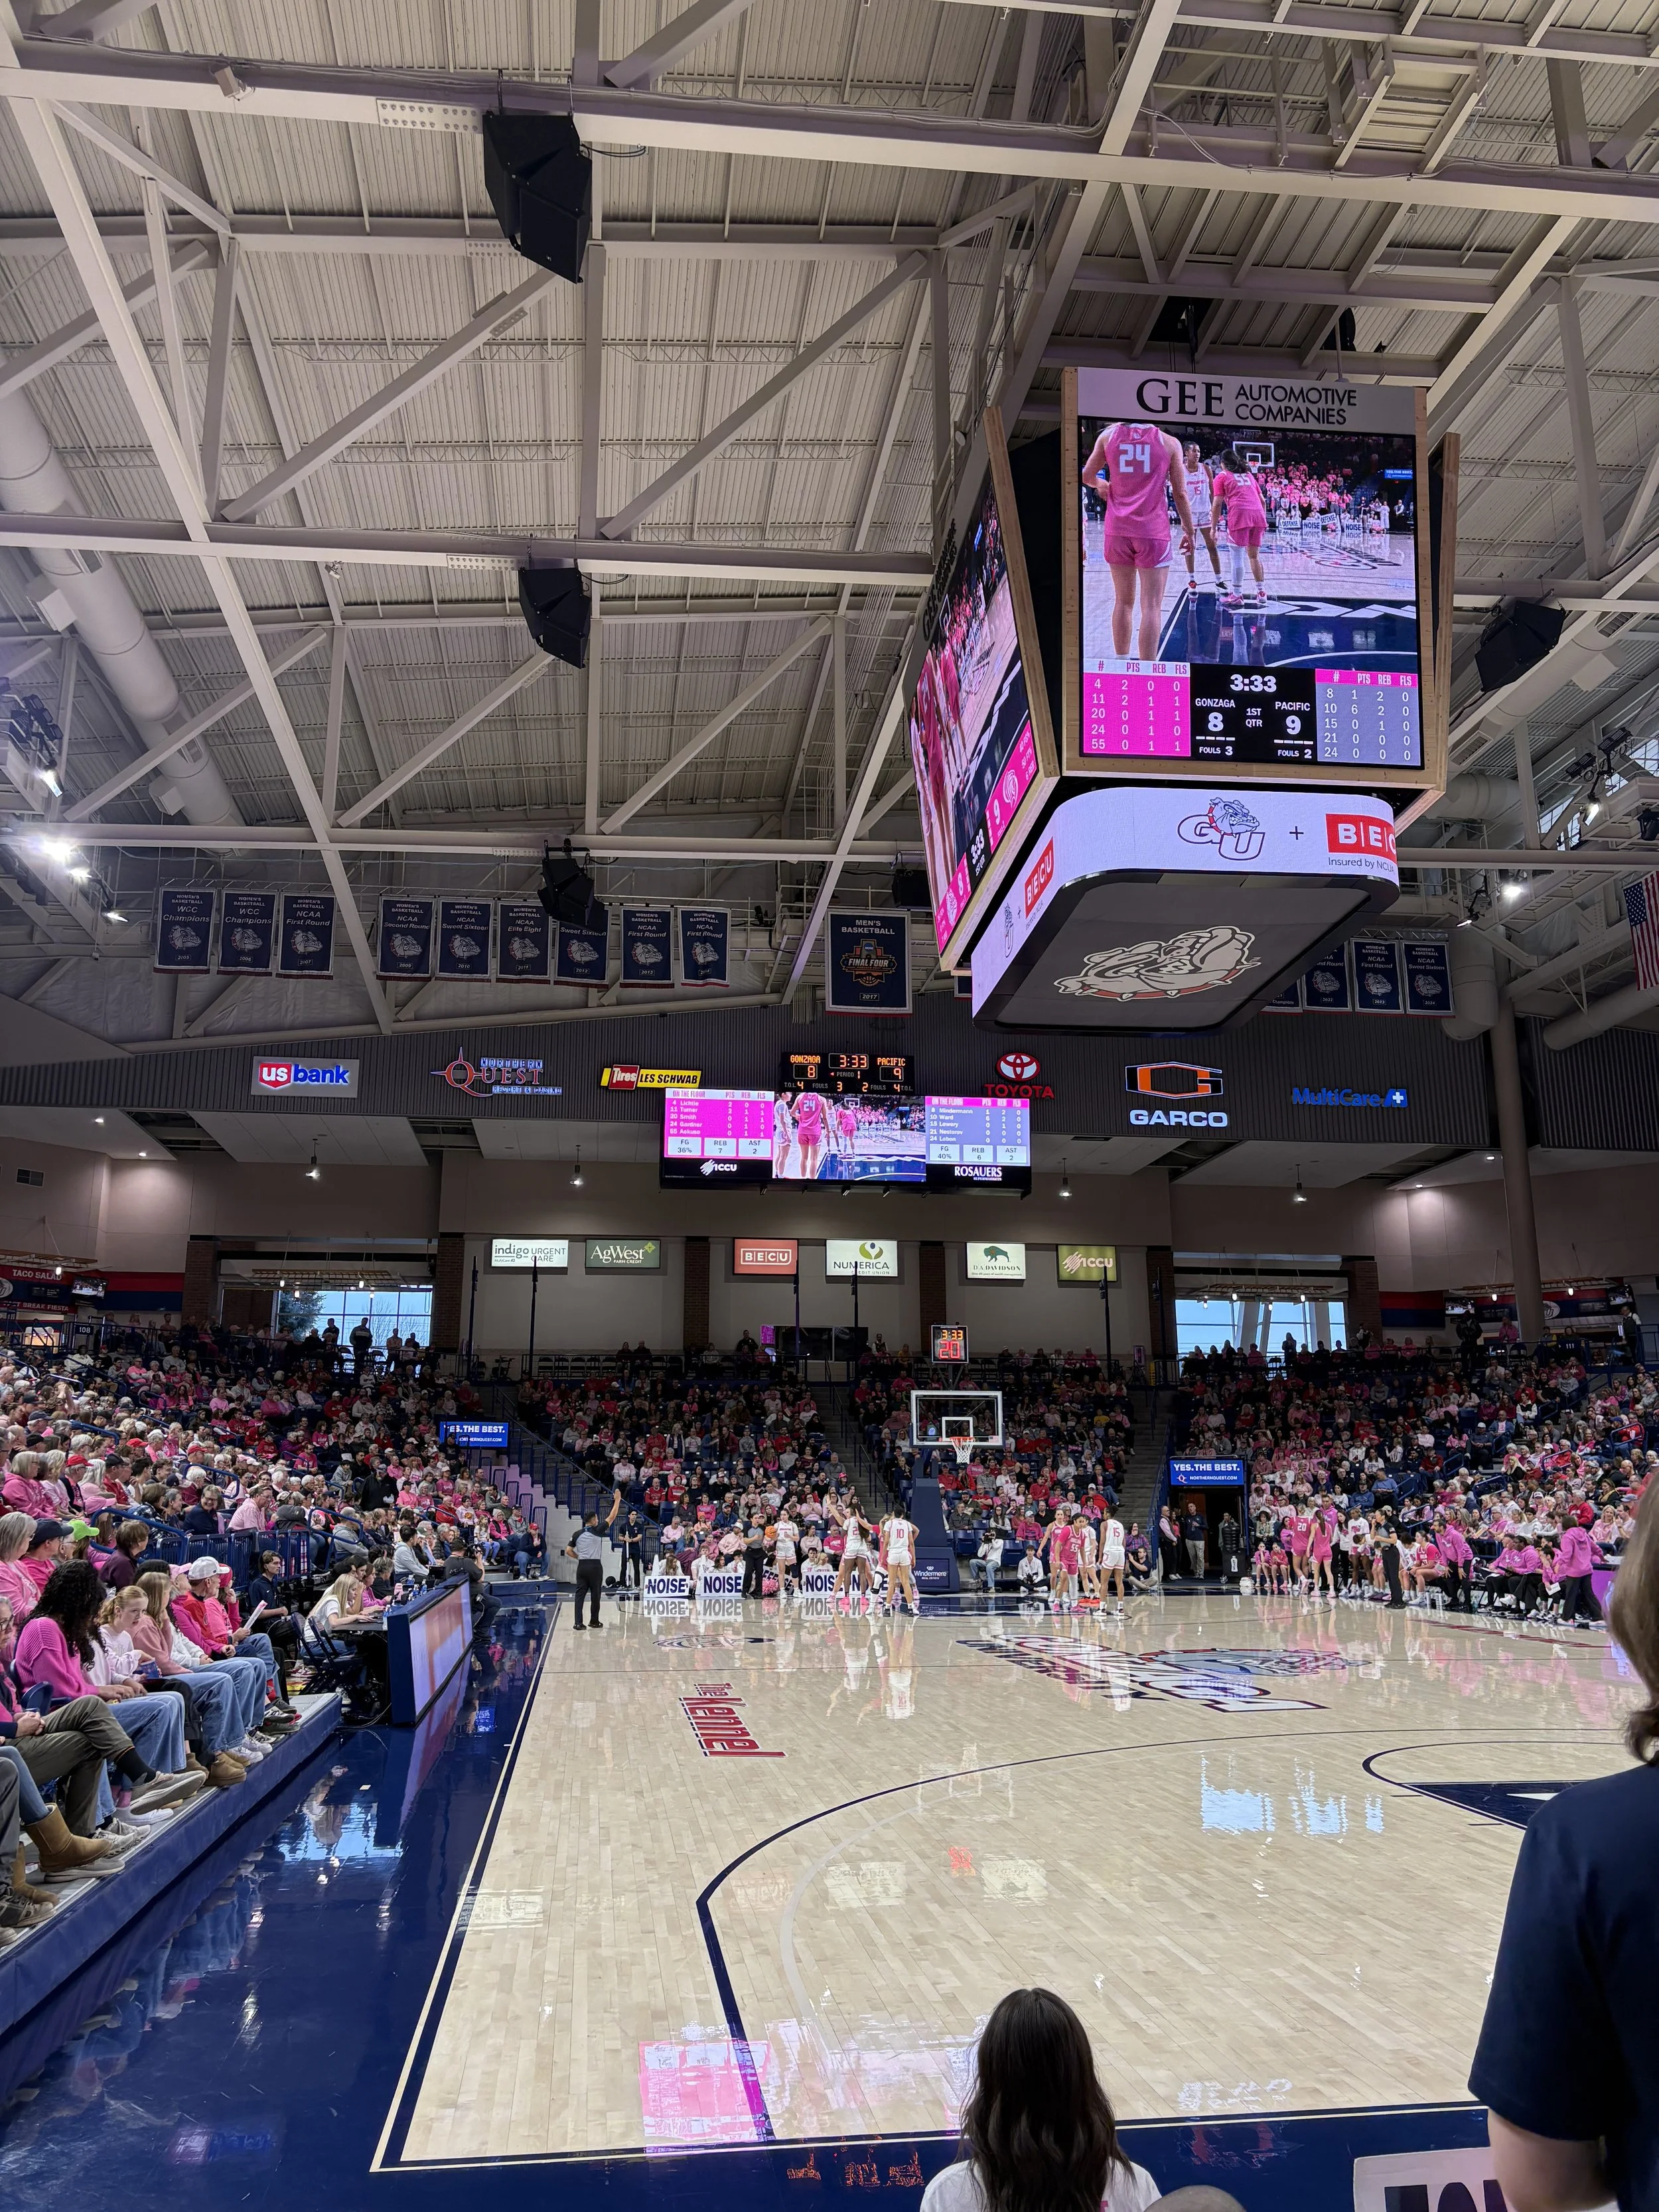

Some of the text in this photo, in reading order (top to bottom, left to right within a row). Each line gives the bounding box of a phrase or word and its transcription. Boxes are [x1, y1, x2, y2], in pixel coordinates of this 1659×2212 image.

[1136, 378, 1224, 417] GEE
[1236, 384, 1357, 406] AUTOMOTIVE
[1235, 404, 1346, 425] COMPANIES
[1119, 444, 1150, 473] 24
[1234, 473, 1251, 486] 55
[1304, 521, 1320, 530] NOISE
[1098, 660, 1187, 674] # PTS REB FLS
[1094, 678, 1180, 692] 4 2 0 0
[1230, 674, 1276, 692] 3:33
[1357, 674, 1370, 684] PTS
[1378, 674, 1391, 685] REB
[1400, 675, 1411, 686] FLS
[1092, 694, 1180, 706] 11 2 1 1
[1327, 688, 1409, 702] 8 1 2 0
[1195, 698, 1236, 708] GONZAGA
[1275, 701, 1311, 711] PACIFIC
[1091, 708, 1180, 721] 20 0 1 1
[1208, 712, 1224, 731] 8
[1246, 719, 1262, 727] QTR
[1285, 715, 1301, 735] 9
[1091, 724, 1181, 736] 24 0 1 0
[1092, 739, 1180, 751] 55 0 1 1
[1225, 746, 1233, 756] 3
[1304, 749, 1312, 759] 2
[1329, 857, 1362, 866] Insured
[1364, 859, 1374, 869] by
[163, 914, 210, 922] Champions
[225, 917, 272, 925] Champions
[480, 1058, 542, 1069] NORTHERN
[790, 1055, 820, 1063] GONZAGA
[840, 1055, 867, 1068] 3:33
[877, 1057, 906, 1066] PACIFIC
[293, 1064, 349, 1083] bank
[613, 1068, 697, 1084] Tires LES SCHWAB
[808, 1066, 816, 1077] 8
[857, 1070, 861, 1079] 1
[894, 1068, 901, 1080] 9
[798, 1081, 804, 1090] 4
[837, 1082, 843, 1091] 3
[862, 1082, 868, 1092] 2
[984, 1084, 1054, 1099] TOYOTA
[1292, 1087, 1381, 1107] MultiCare
[1129, 1110, 1228, 1127] GARCO
[954, 1166, 1002, 1177] ROSAUERS
[494, 1243, 529, 1259] indigo
[591, 1245, 646, 1263] AgWest
[833, 1261, 889, 1270] NUMERICA
[35, 1272, 62, 1281] SALAD
[942, 1329, 963, 1340] 3:33
[939, 1341, 960, 1359] 20
[1113, 1527, 1121, 1538] 15
[1297, 1523, 1307, 1532] 20
[896, 1530, 904, 1539] 10
[648, 1578, 687, 1594] NOISE
[703, 1576, 742, 1593] NOISE
[678, 1696, 788, 1757] Kennel
